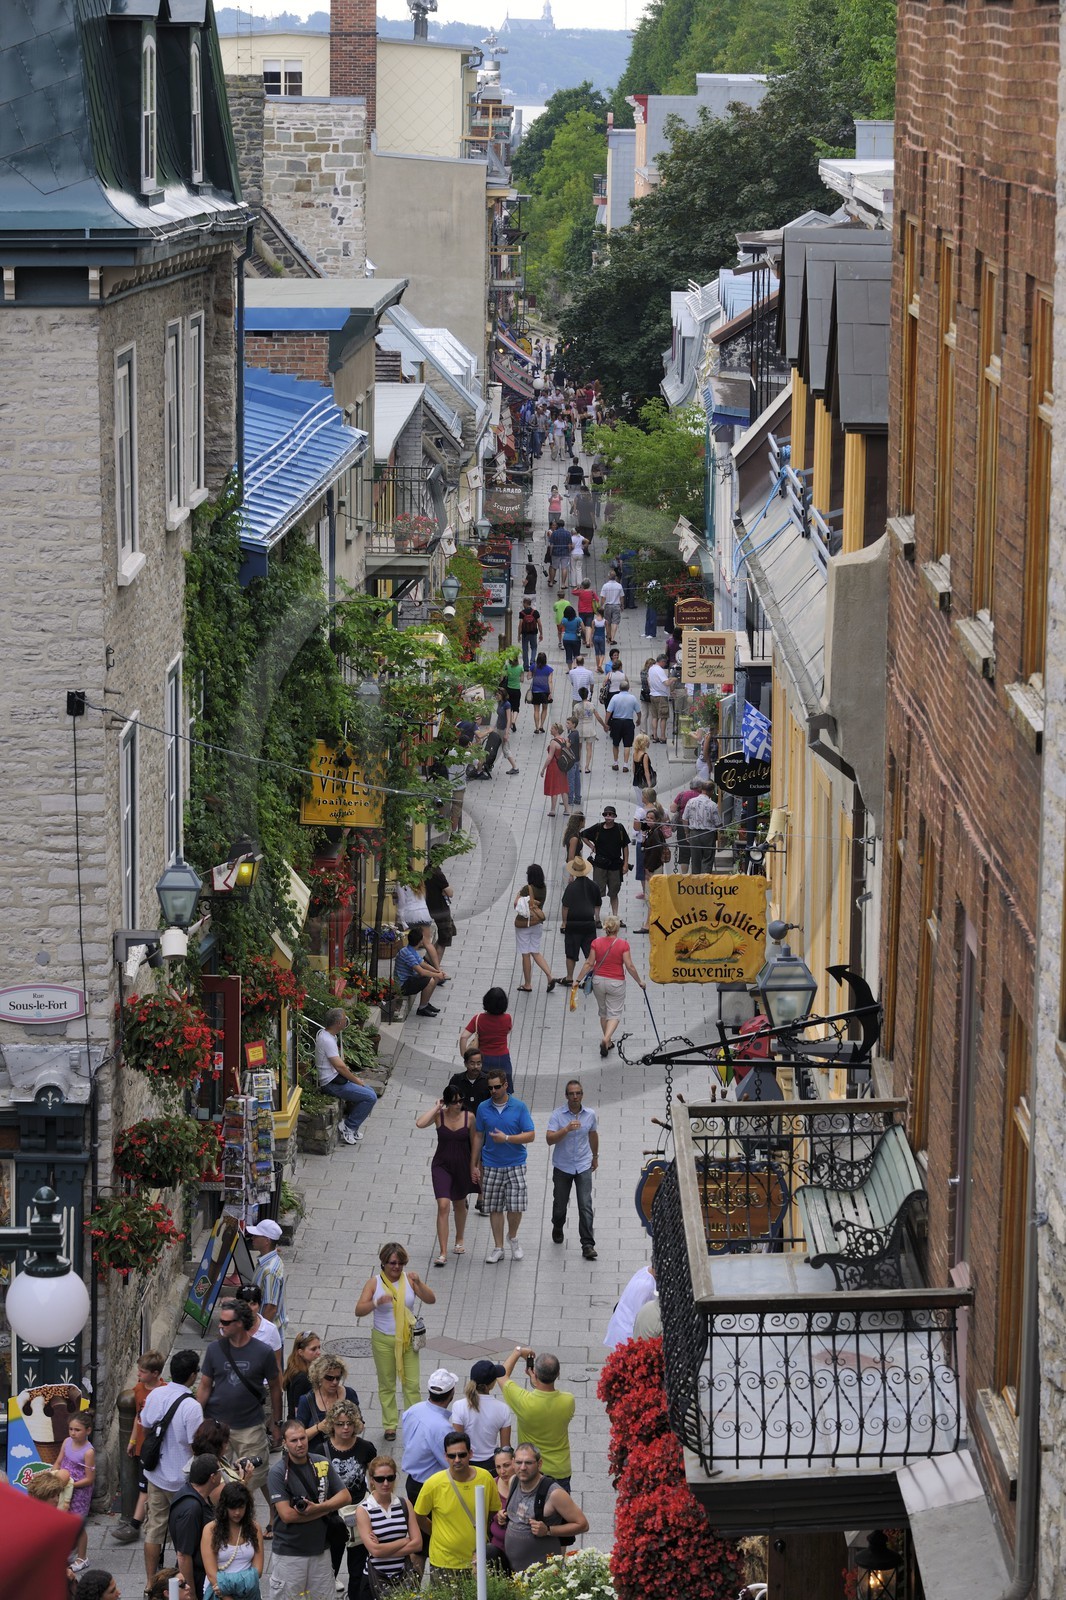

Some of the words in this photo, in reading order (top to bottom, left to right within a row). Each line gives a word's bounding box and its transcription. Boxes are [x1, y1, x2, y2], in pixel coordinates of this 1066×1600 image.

[687, 637, 697, 678] GALERIE
[699, 644, 726, 655] D'ART
[677, 878, 739, 900] boutique
[651, 907, 708, 941] Louis
[710, 902, 766, 941] Jolliet
[672, 964, 744, 981] souvenirs
[8, 1000, 67, 1011] Sous-le-Fort
